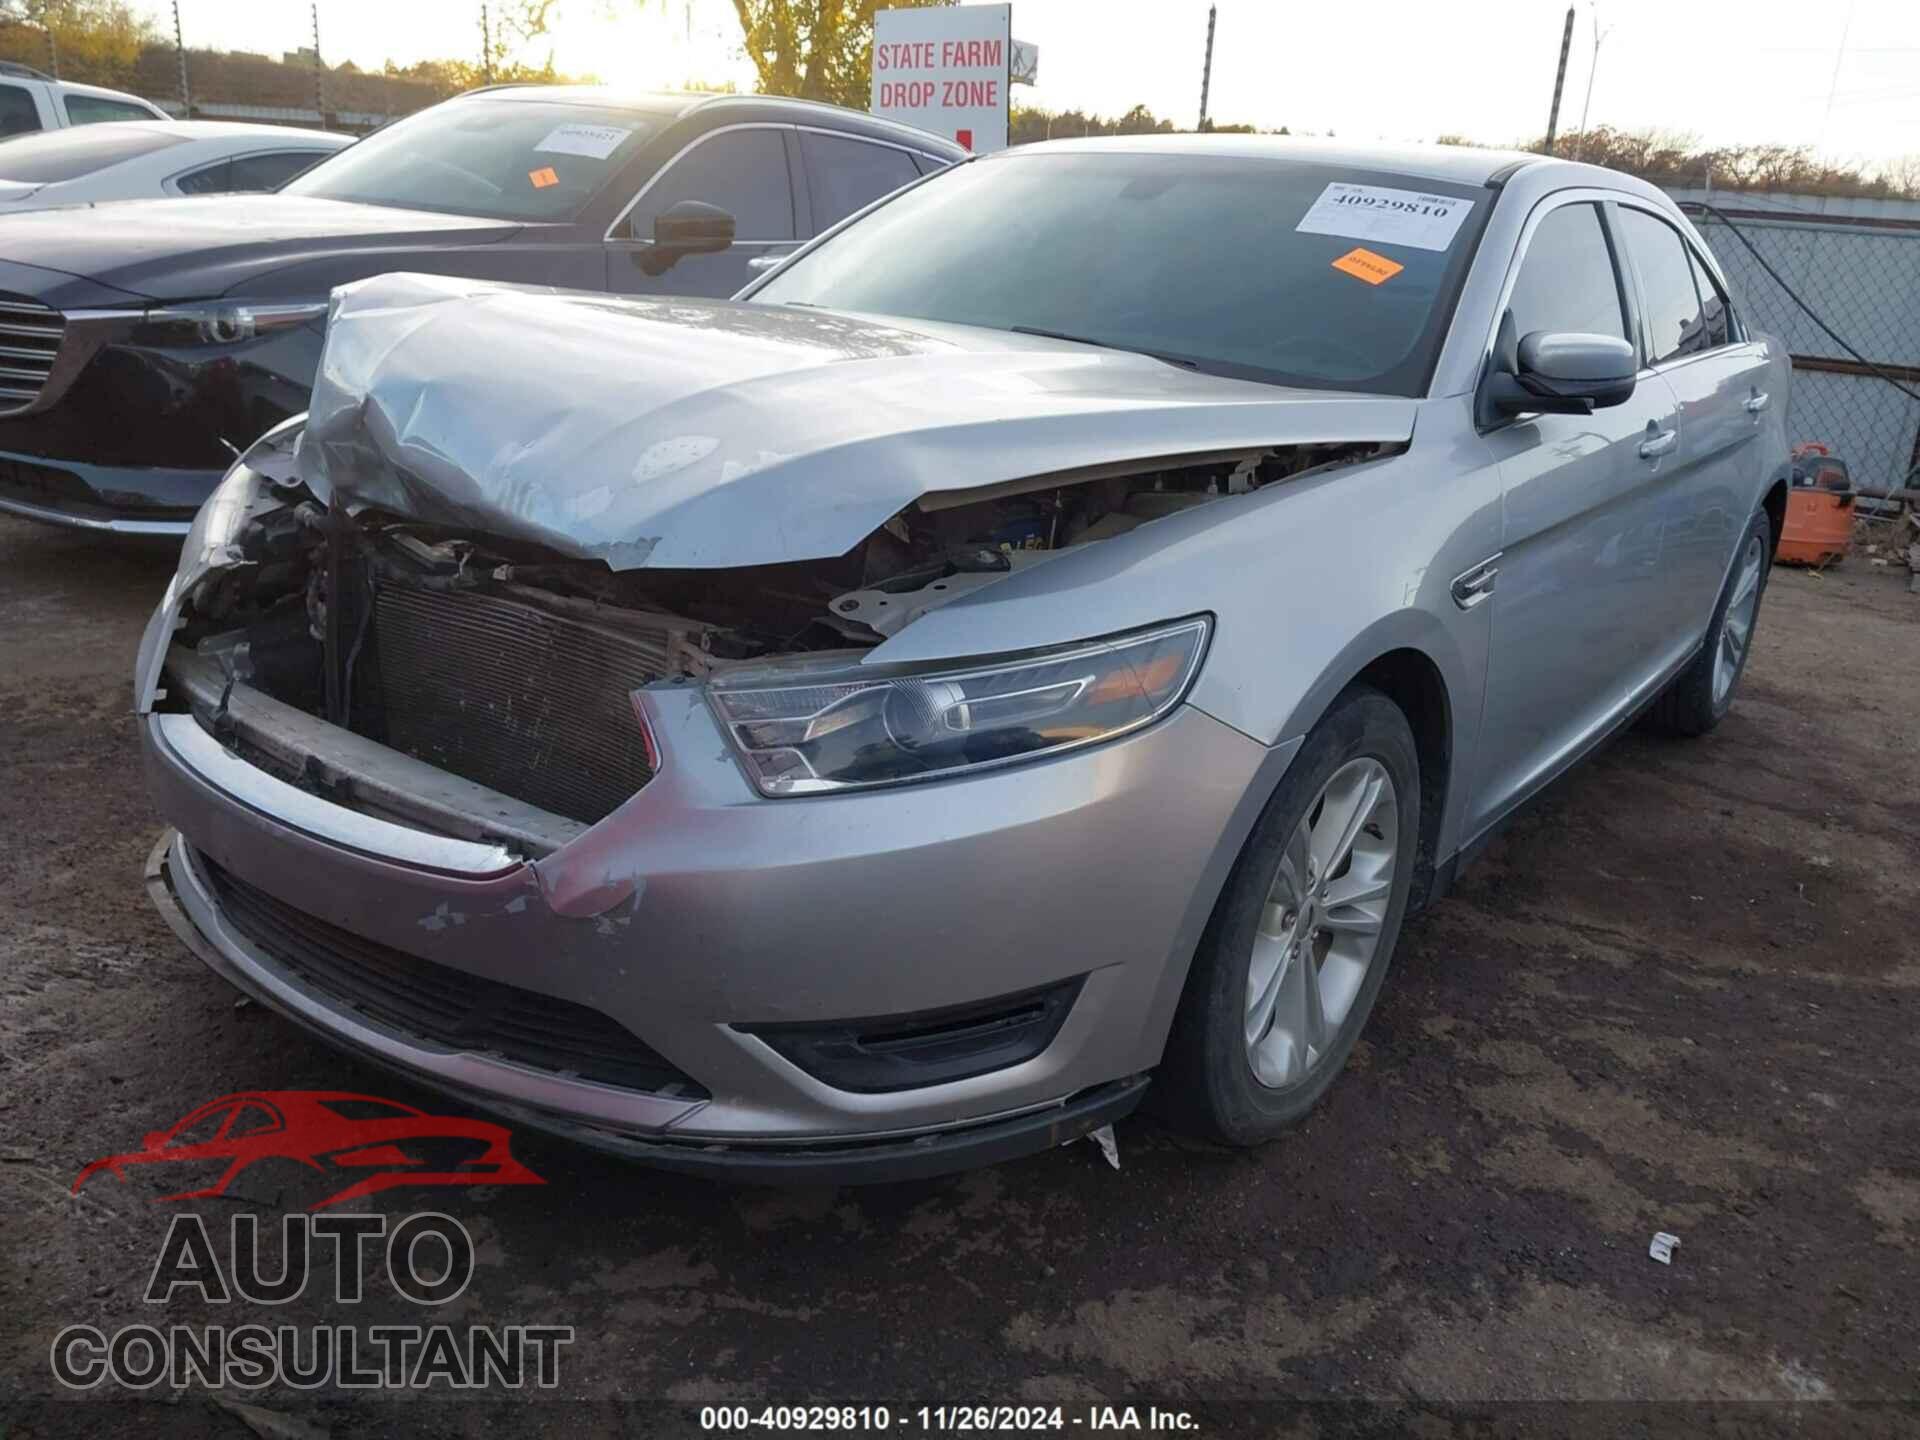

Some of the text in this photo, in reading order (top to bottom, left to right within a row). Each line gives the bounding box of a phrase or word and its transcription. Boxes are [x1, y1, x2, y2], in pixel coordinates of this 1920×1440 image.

[878, 40, 1001, 69] STATE FARM
[880, 81, 997, 108] DROP ZONE
[1333, 194, 1448, 217] 40929810
